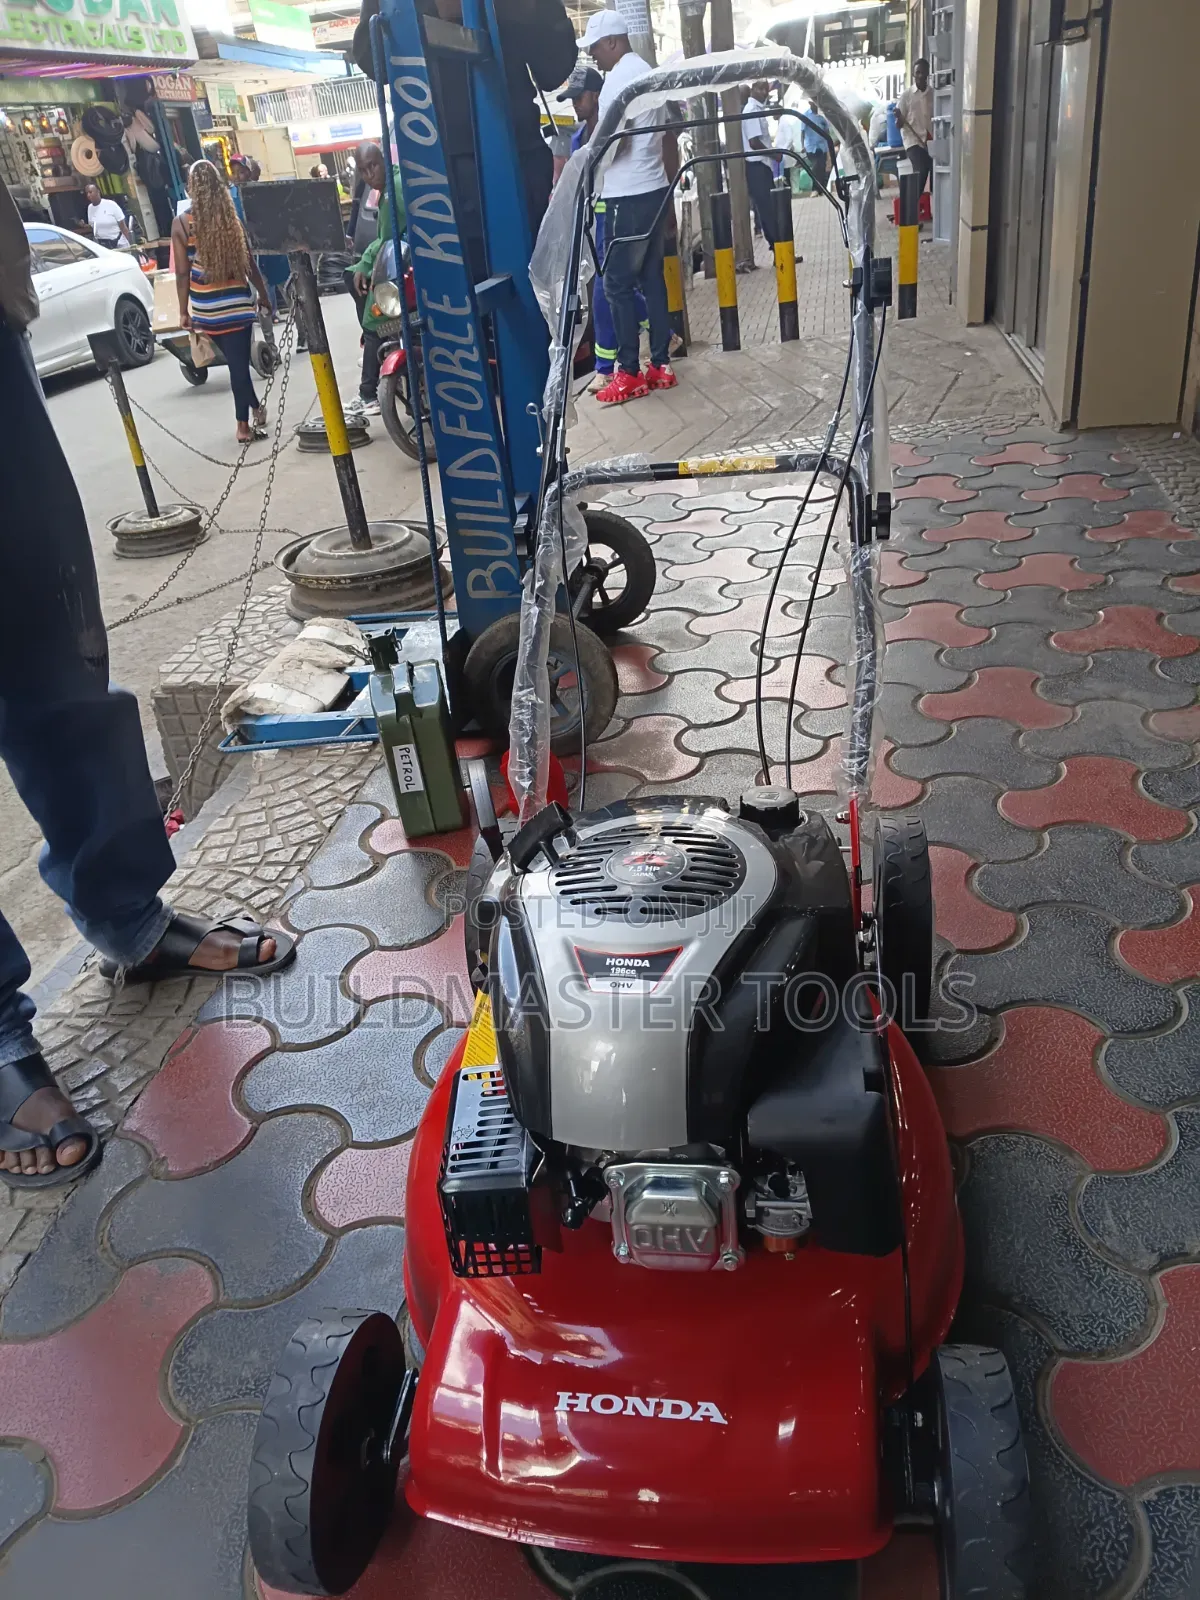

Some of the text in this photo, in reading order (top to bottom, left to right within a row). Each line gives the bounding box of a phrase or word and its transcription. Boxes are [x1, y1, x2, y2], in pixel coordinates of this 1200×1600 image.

[150, 28, 188, 54] LTD
[390, 55, 519, 600] BUILDFORCE KDV 001
[399, 747, 415, 790] PETROL
[605, 957, 650, 967] HONDA
[610, 966, 637, 975] 196cc
[609, 981, 634, 989] OHV
[630, 1223, 710, 1252] OHV
[553, 1391, 729, 1425] HONDA
